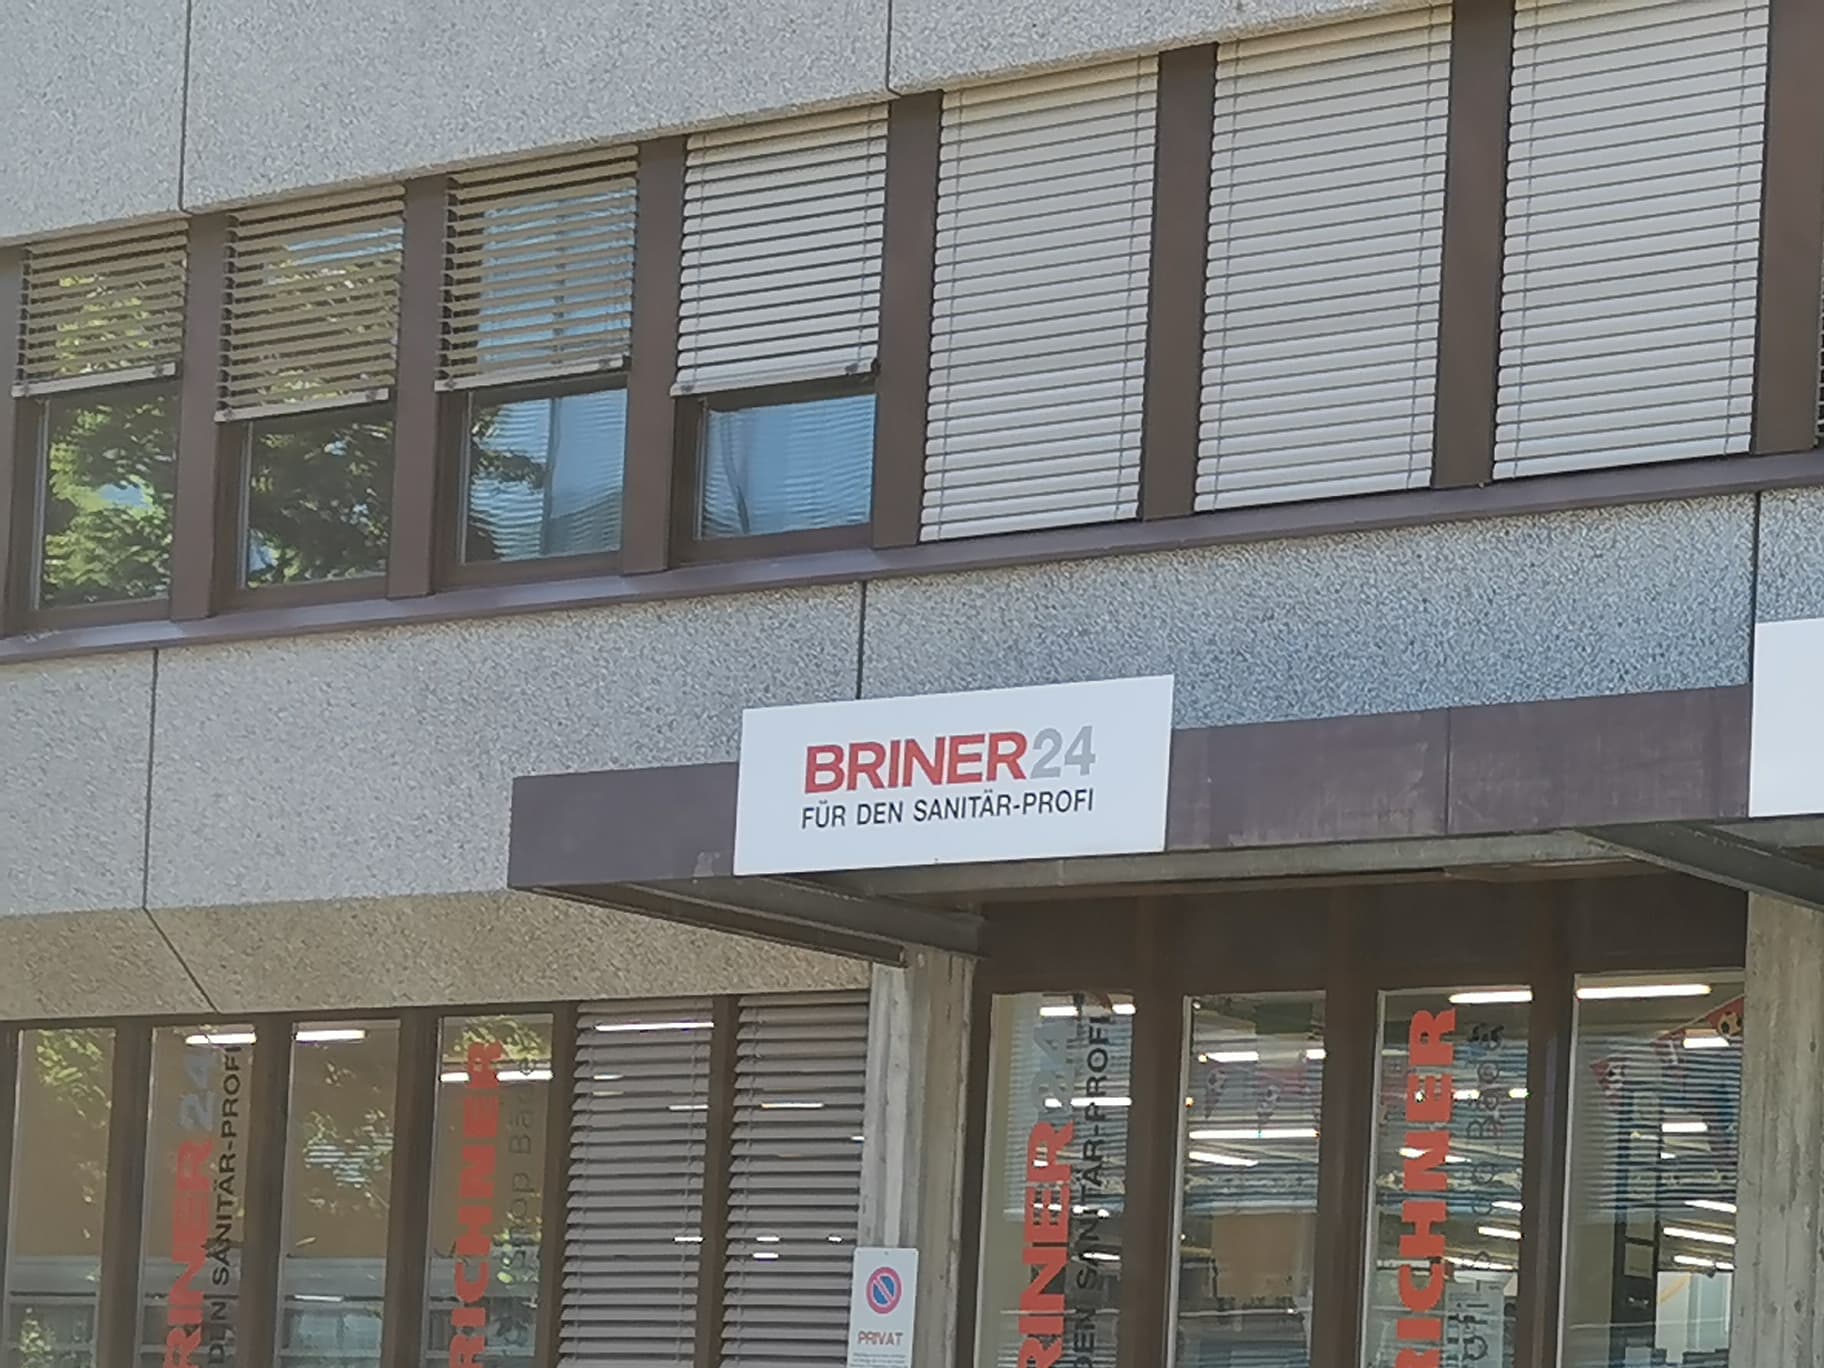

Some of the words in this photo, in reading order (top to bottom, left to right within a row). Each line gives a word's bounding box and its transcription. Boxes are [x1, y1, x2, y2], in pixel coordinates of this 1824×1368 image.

[804, 725, 1096, 795] BRINER24
[800, 799, 847, 829] FÜR
[856, 801, 903, 826] DEN
[913, 787, 1095, 822] SANITÄR-PROFI
[210, 1046, 242, 1287] SANITÄR-PROFI
[857, 1330, 904, 1346] PRIVAT
